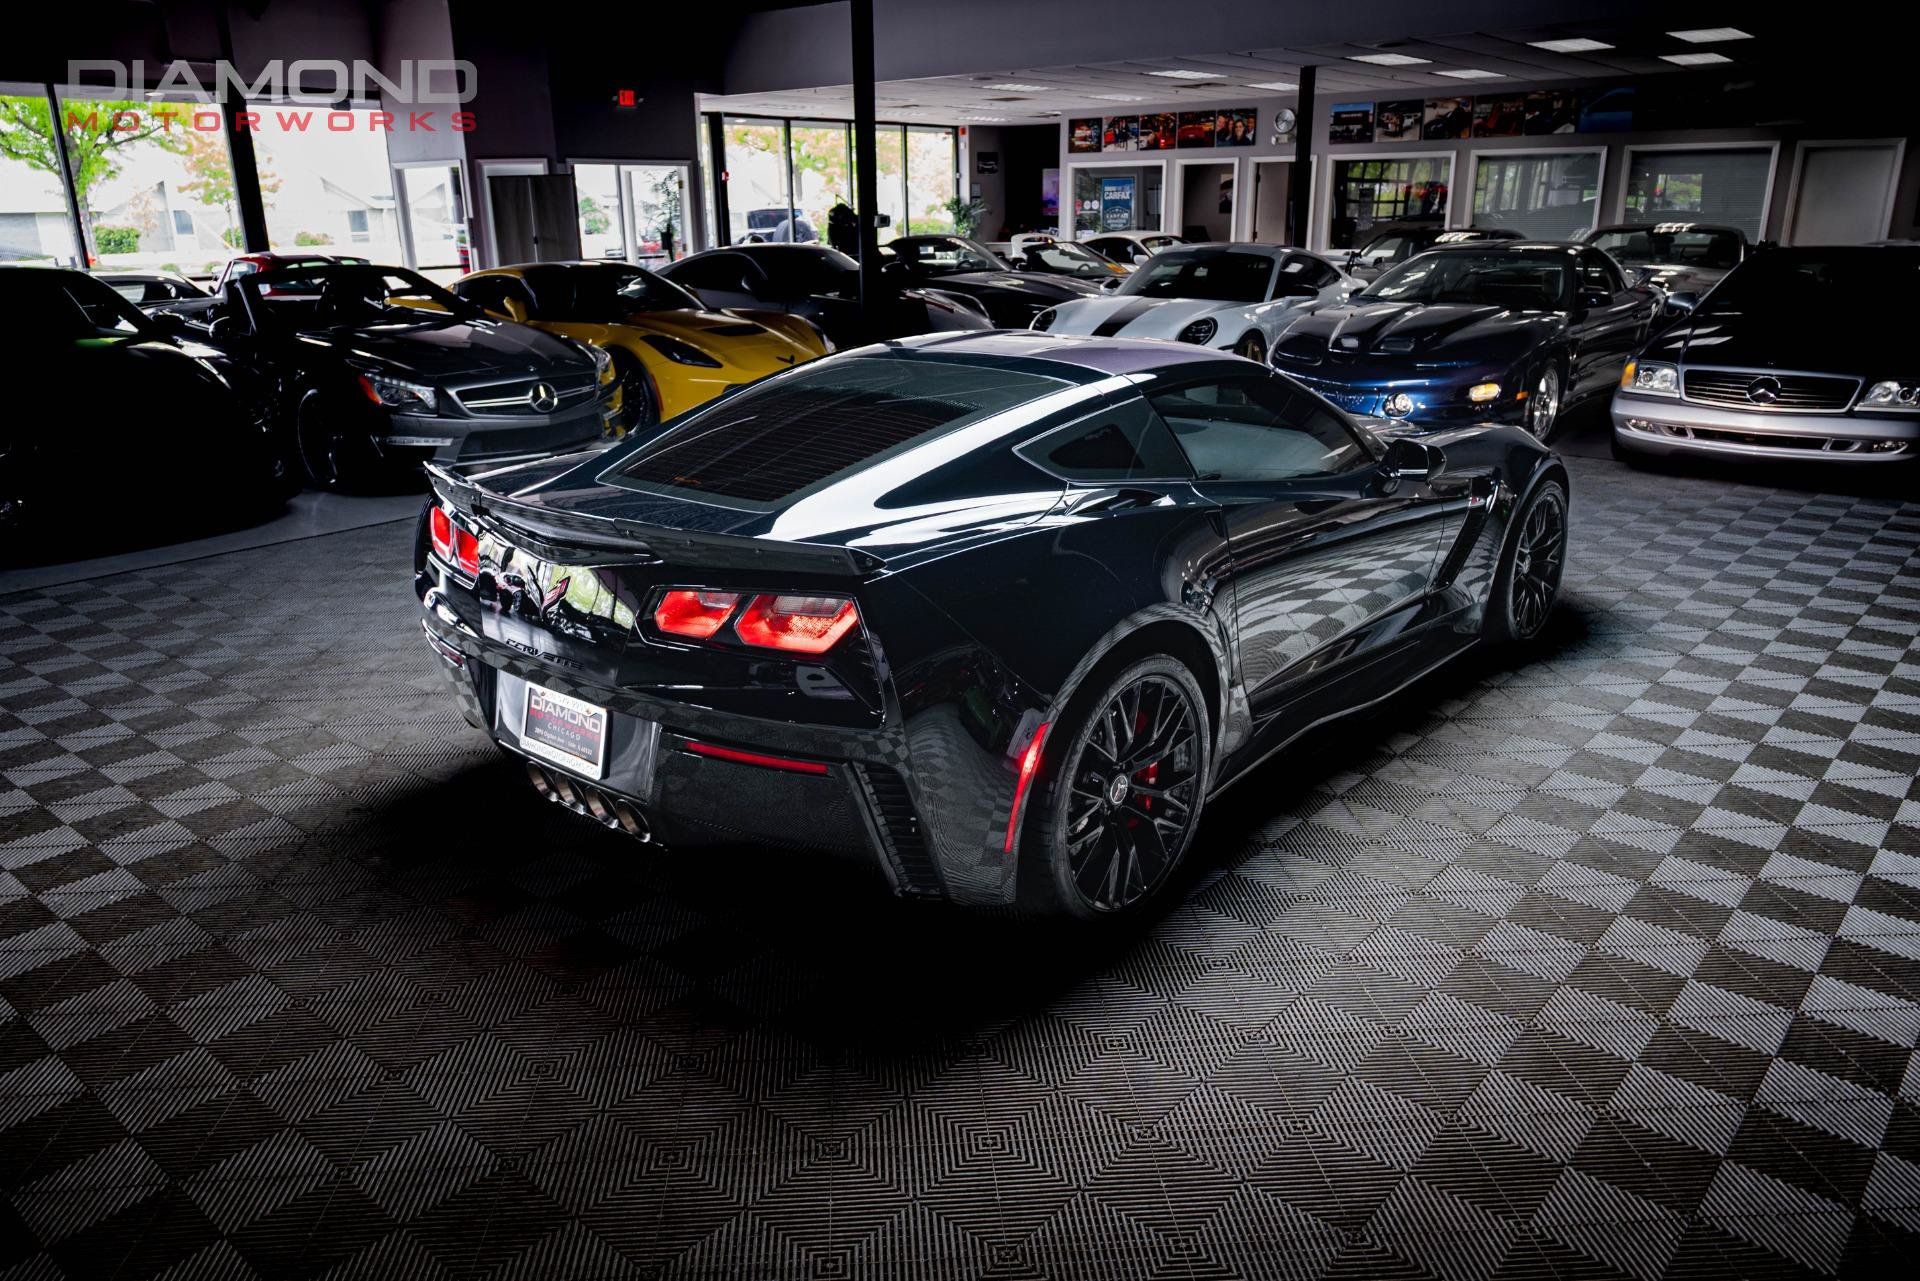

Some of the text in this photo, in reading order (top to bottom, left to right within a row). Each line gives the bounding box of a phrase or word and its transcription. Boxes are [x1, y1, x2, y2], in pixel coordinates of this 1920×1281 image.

[1104, 191, 1130, 200] CARFAX
[531, 695, 600, 734] DIAMOND
[547, 722, 581, 740] CHICAGO
